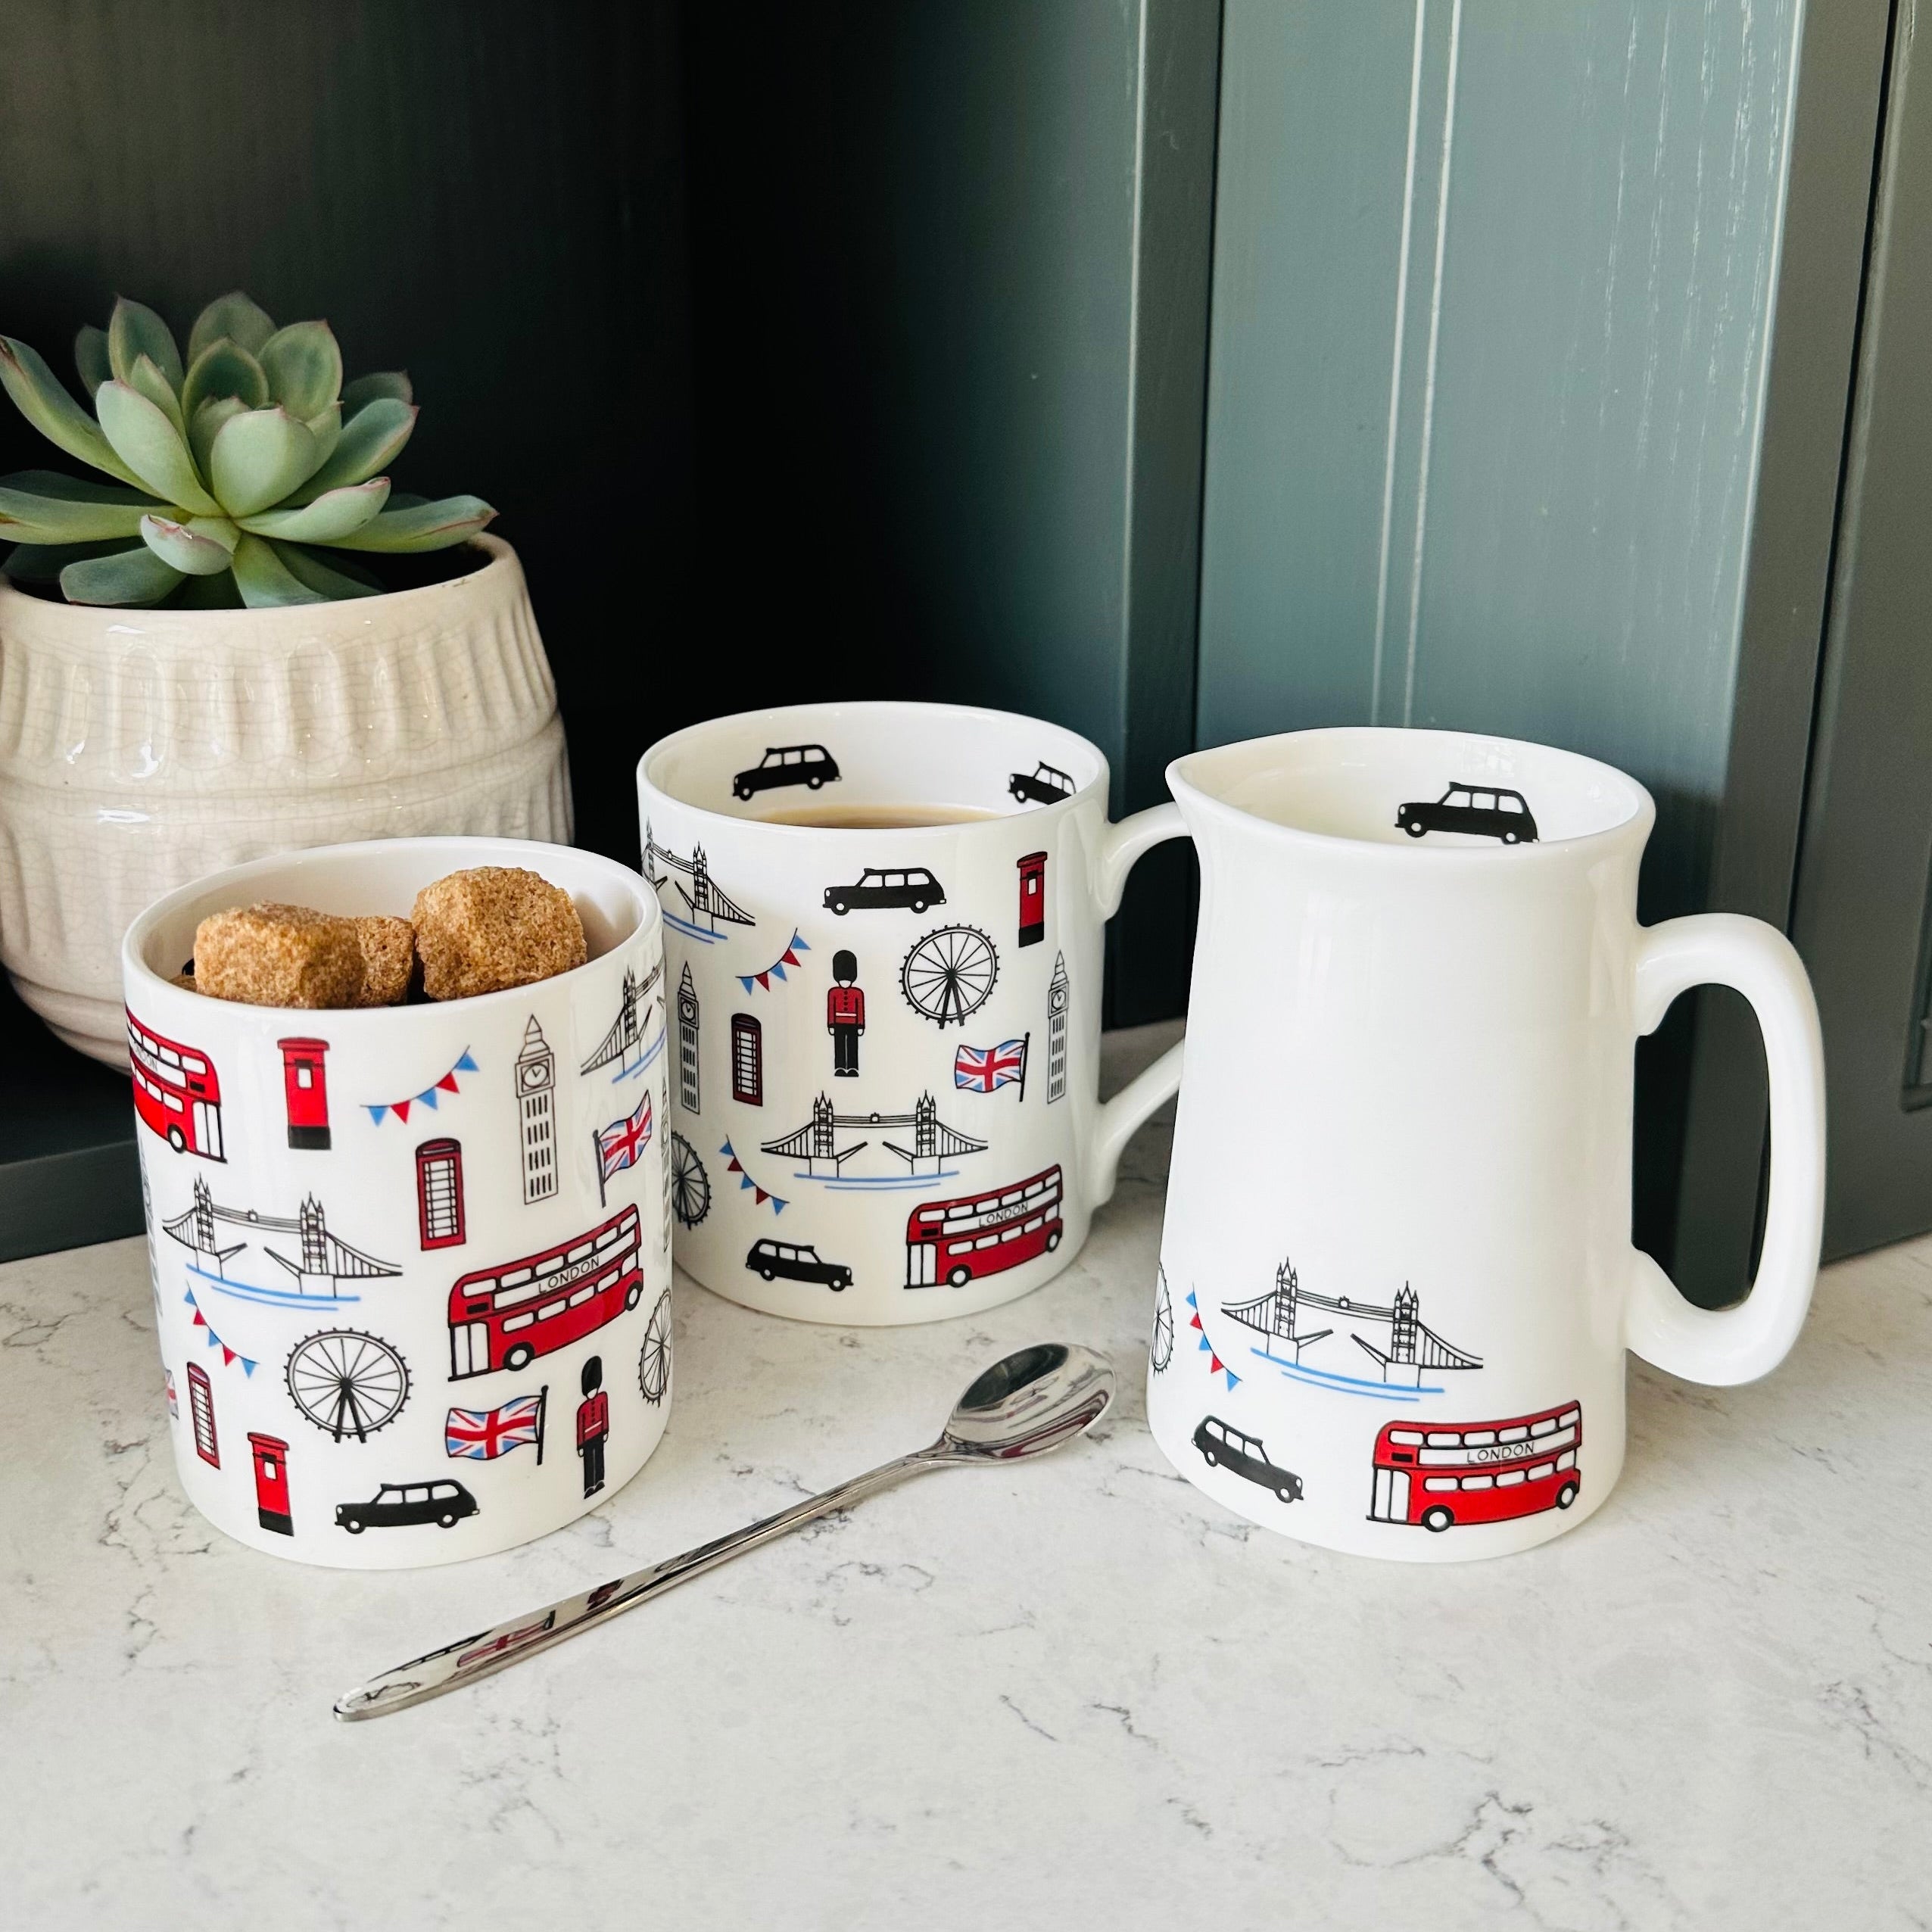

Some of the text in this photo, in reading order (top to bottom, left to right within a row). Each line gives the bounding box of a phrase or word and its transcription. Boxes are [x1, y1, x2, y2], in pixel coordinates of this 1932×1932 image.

[979, 1201, 1028, 1226] LONDON
[538, 1255, 600, 1293] LONDON
[1466, 1441, 1535, 1463] LONDON
